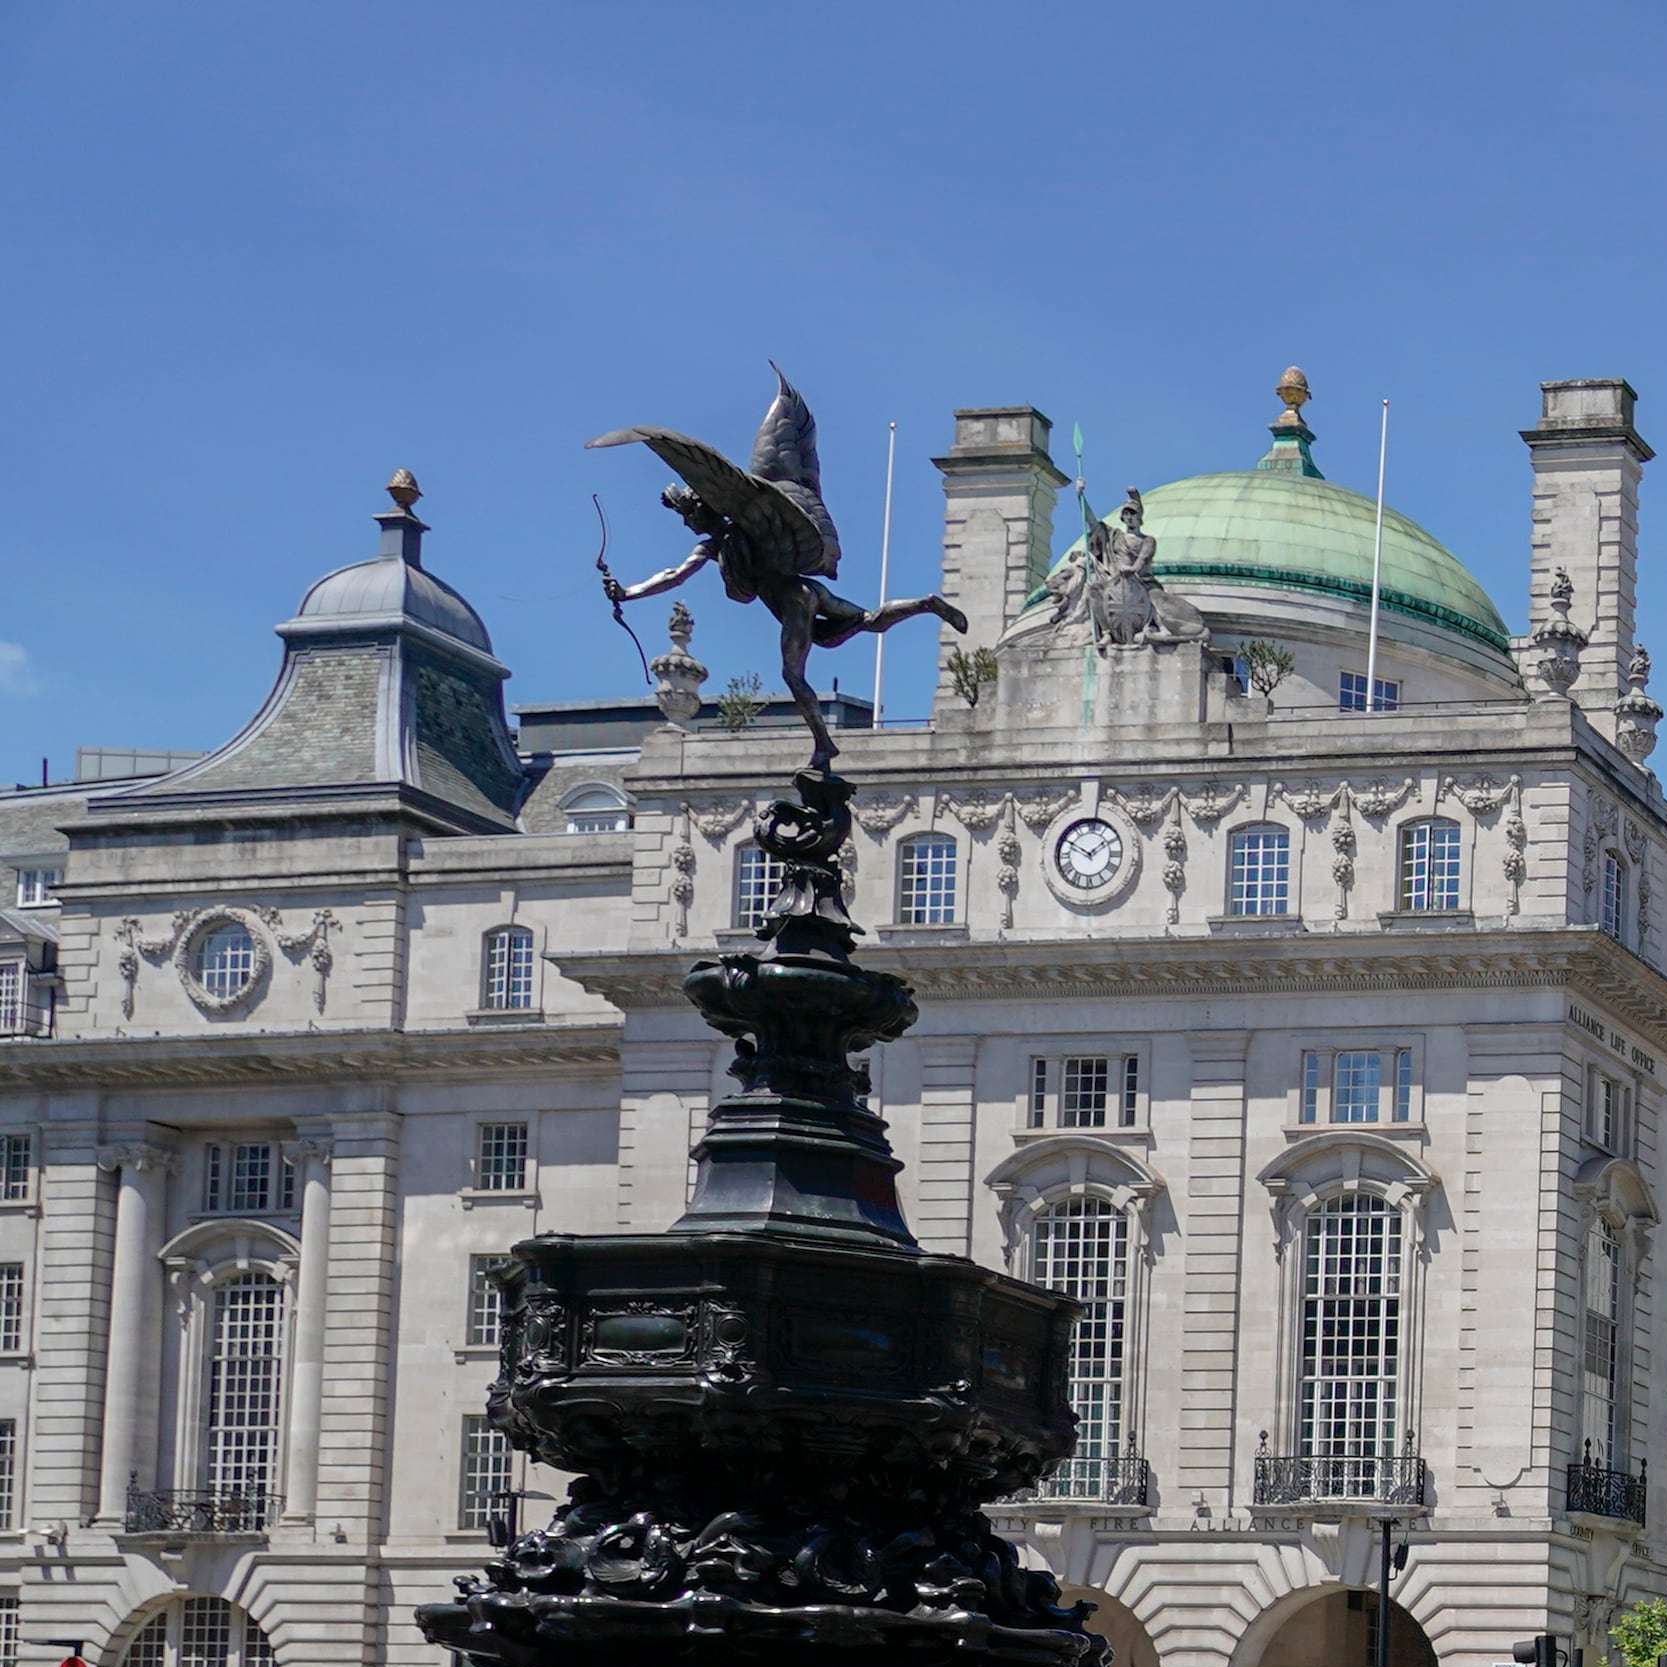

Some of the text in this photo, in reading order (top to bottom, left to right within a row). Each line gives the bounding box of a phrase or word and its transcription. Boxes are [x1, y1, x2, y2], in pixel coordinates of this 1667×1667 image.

[1568, 1004, 1656, 1075] ALLIANCE LIFE OFFICE
[1089, 1517, 1141, 1531] FIRE
[1189, 1517, 1306, 1532] ALLIANCE
[1366, 1518, 1418, 1531] LE
